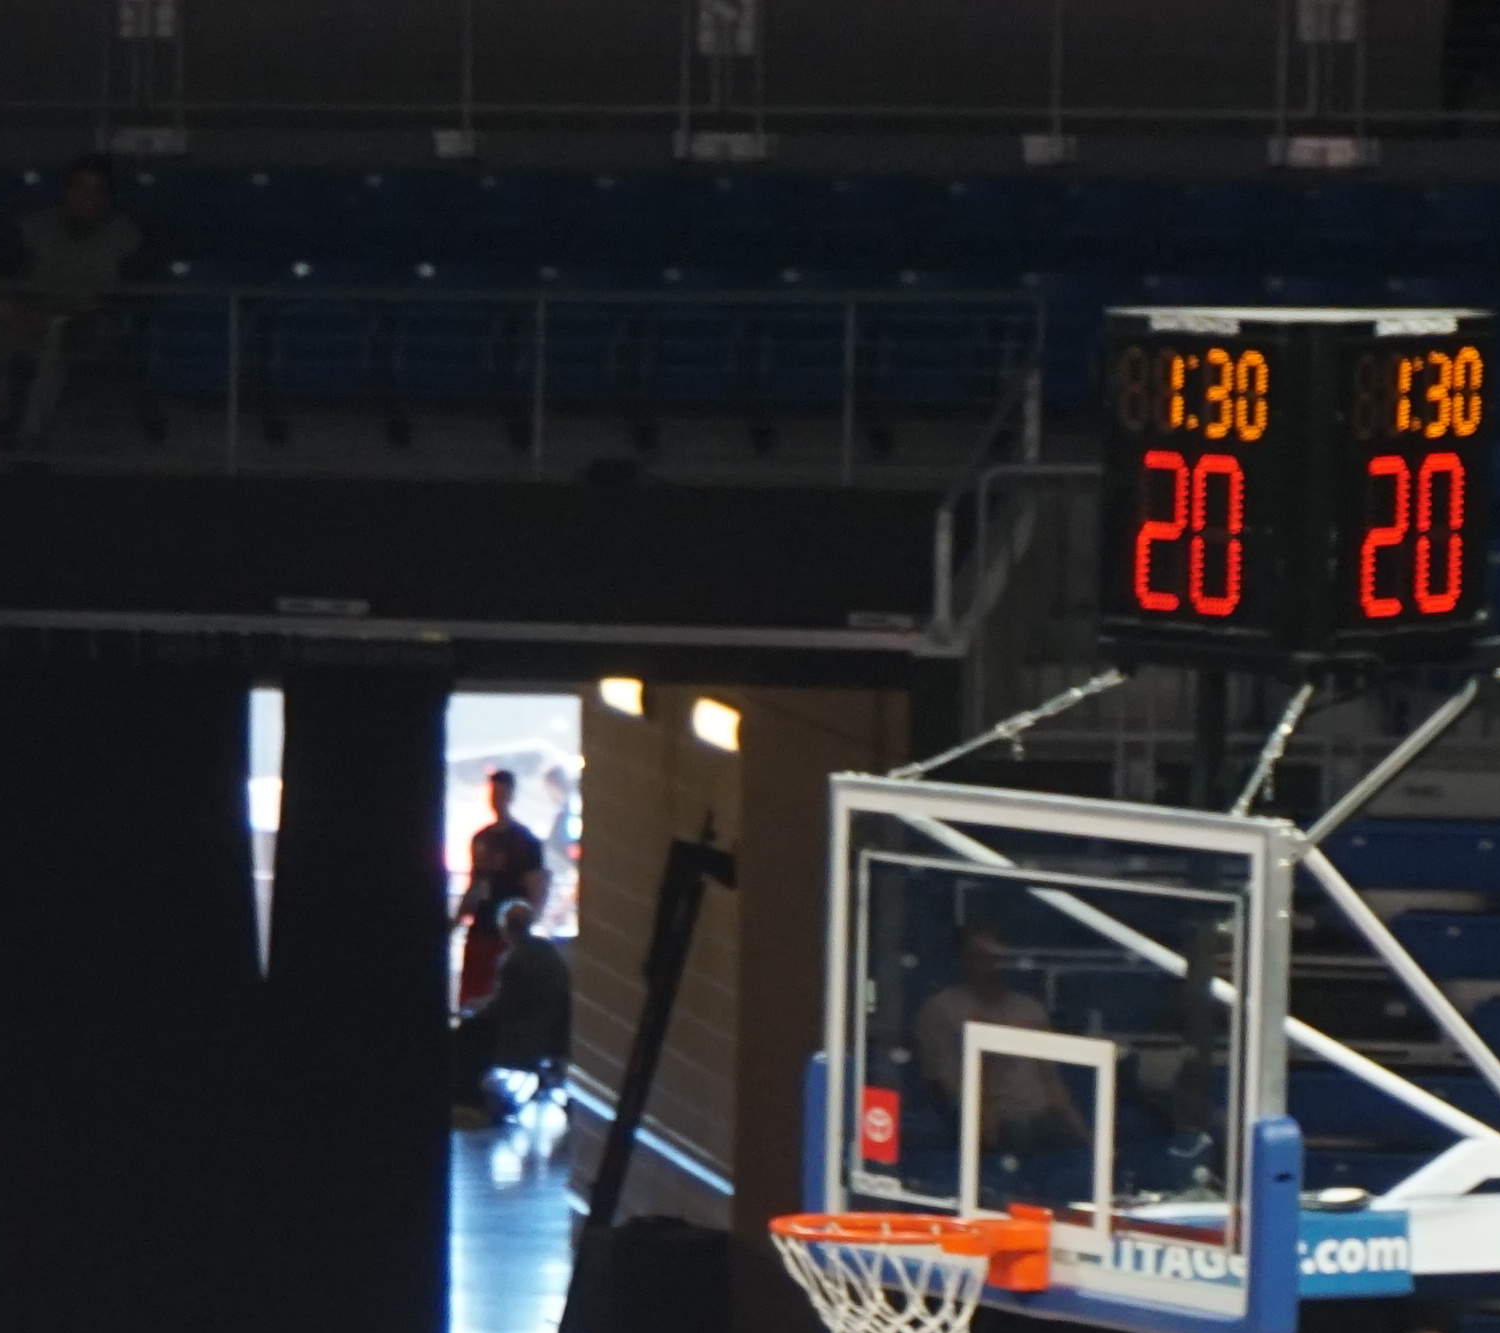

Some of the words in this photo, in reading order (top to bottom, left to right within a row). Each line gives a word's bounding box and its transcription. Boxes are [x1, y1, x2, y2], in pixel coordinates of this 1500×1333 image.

[1169, 347, 1269, 441] 1:30
[1397, 346, 1484, 439] 1:30
[1134, 450, 1245, 617] 20
[1360, 451, 1466, 618] 20
